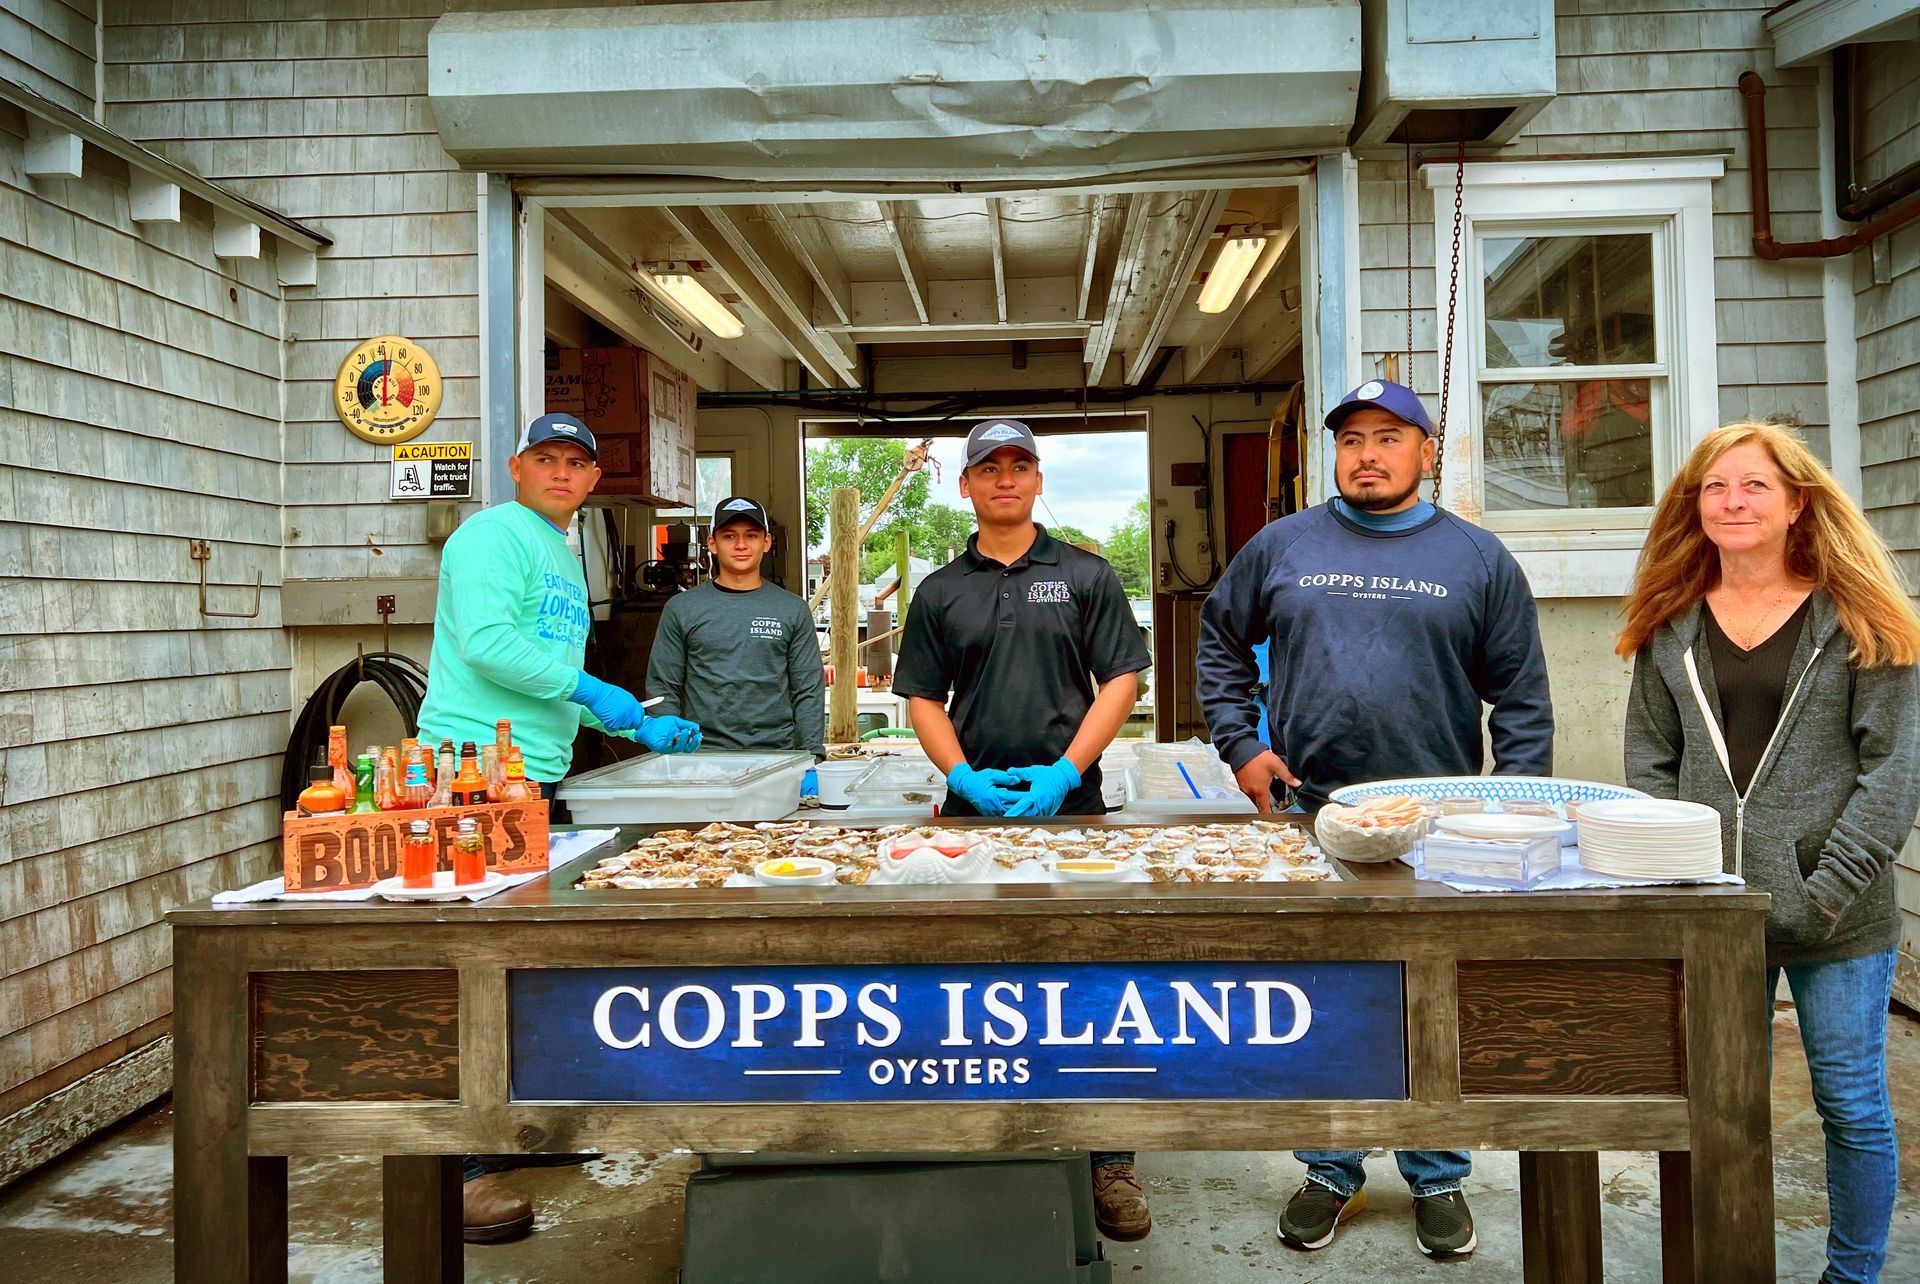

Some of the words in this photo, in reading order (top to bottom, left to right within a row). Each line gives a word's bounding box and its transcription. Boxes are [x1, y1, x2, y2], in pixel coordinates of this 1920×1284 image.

[377, 344, 386, 356] 40
[398, 348, 407, 359] 60
[357, 353, 366, 365] 20
[414, 363, 423, 374] 80
[349, 371, 355, 383] 0
[418, 385, 430, 396] 100
[342, 391, 354, 402] -20
[349, 408, 361, 419] -40
[412, 405, 424, 416] 120
[411, 446, 467, 458] CAUTION
[434, 463, 456, 471] Watch
[457, 462, 468, 471] for
[434, 473, 448, 481] fork
[449, 473, 468, 481] truck
[433, 483, 456, 491] traffic.
[544, 573, 561, 590] EAT
[1299, 573, 1365, 588] COPPS
[1370, 576, 1448, 598] ISLAND
[1030, 584, 1068, 592] COPPS
[1027, 590, 1070, 600] ISLAND
[1352, 592, 1387, 600] OYSTERS
[539, 593, 571, 620] LOVE
[751, 620, 781, 629] COPPS
[750, 627, 783, 637] ISLAND
[300, 808, 526, 889] BOOER'S
[591, 982, 902, 1050] COPPS
[939, 979, 1314, 1048] ISLAND
[869, 1058, 1032, 1086] OYSTERS
